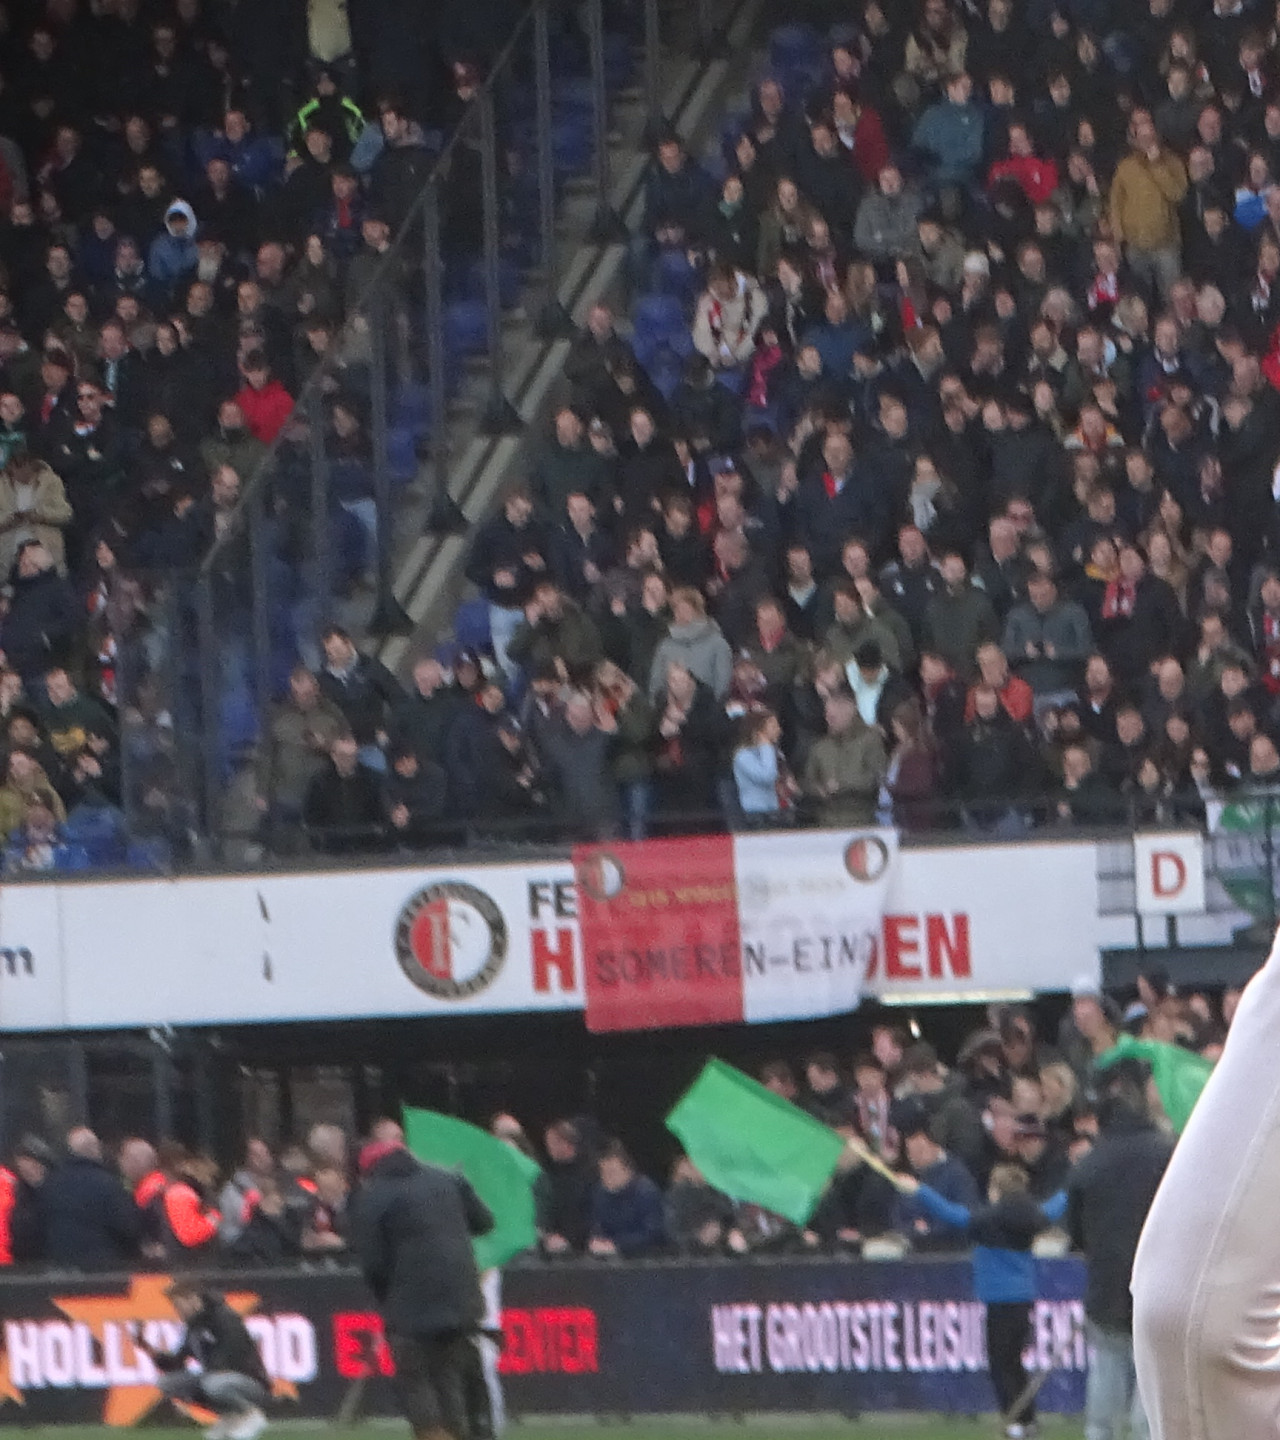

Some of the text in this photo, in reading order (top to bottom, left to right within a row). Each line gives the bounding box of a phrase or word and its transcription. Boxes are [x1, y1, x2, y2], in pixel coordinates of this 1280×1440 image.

[1151, 851, 1187, 898] D
[711, 1302, 763, 1373] HET
[766, 1300, 899, 1373] GROOTSTE
